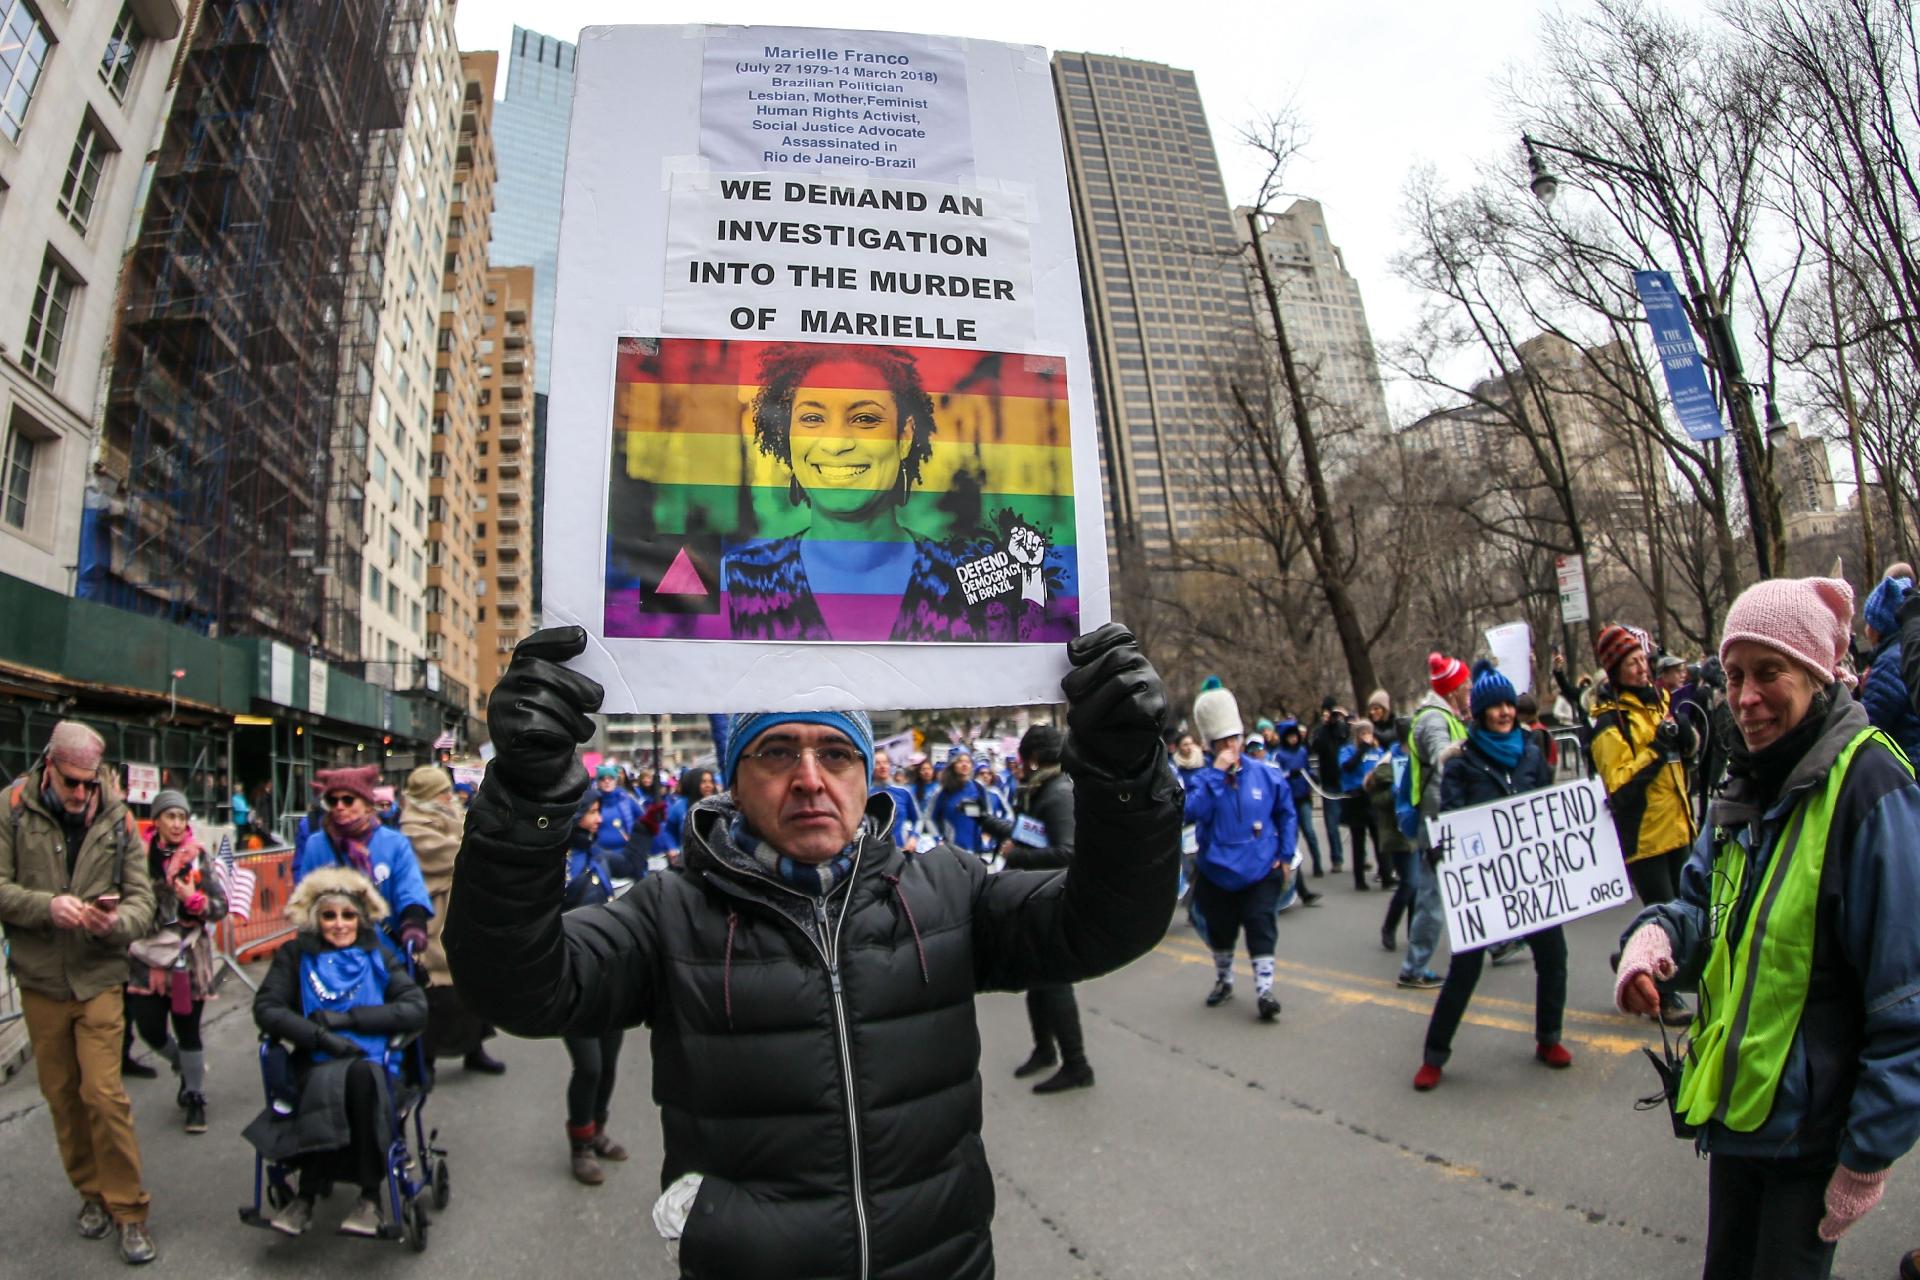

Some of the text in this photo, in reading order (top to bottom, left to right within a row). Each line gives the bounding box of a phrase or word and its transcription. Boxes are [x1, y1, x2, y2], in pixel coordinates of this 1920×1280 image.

[764, 46, 909, 66] Marielle Franco
[735, 62, 938, 85] (July 27 1979-14 March 2018)
[772, 77, 904, 93] Brazilian Politician
[748, 90, 810, 103] Lesbian,
[756, 105, 921, 125] Human Rights Activist,
[752, 119, 926, 139] Social Justice Advocate
[781, 136, 898, 152] Assassinated in
[763, 151, 917, 169] Rio de Janeiro-Brazil
[720, 180, 984, 217] WE DEMAND AN
[717, 220, 988, 257] INVESTIGATION
[689, 261, 1016, 301] INTO THE MURDER
[730, 307, 977, 341] OF MARIELLE
[1662, 329, 1682, 341] THE
[1658, 342, 1696, 356] WINTER
[1666, 356, 1693, 370] SHOW
[956, 551, 1009, 583] DEFEND
[961, 562, 1021, 595] DEMOCRACY
[966, 580, 1015, 605] IN BRAZIL
[1492, 785, 1598, 851] DEFEND
[1443, 827, 1599, 909] DEMOCRACY
[1457, 905, 1488, 945] IN
[1501, 878, 1579, 931] BRAZIL
